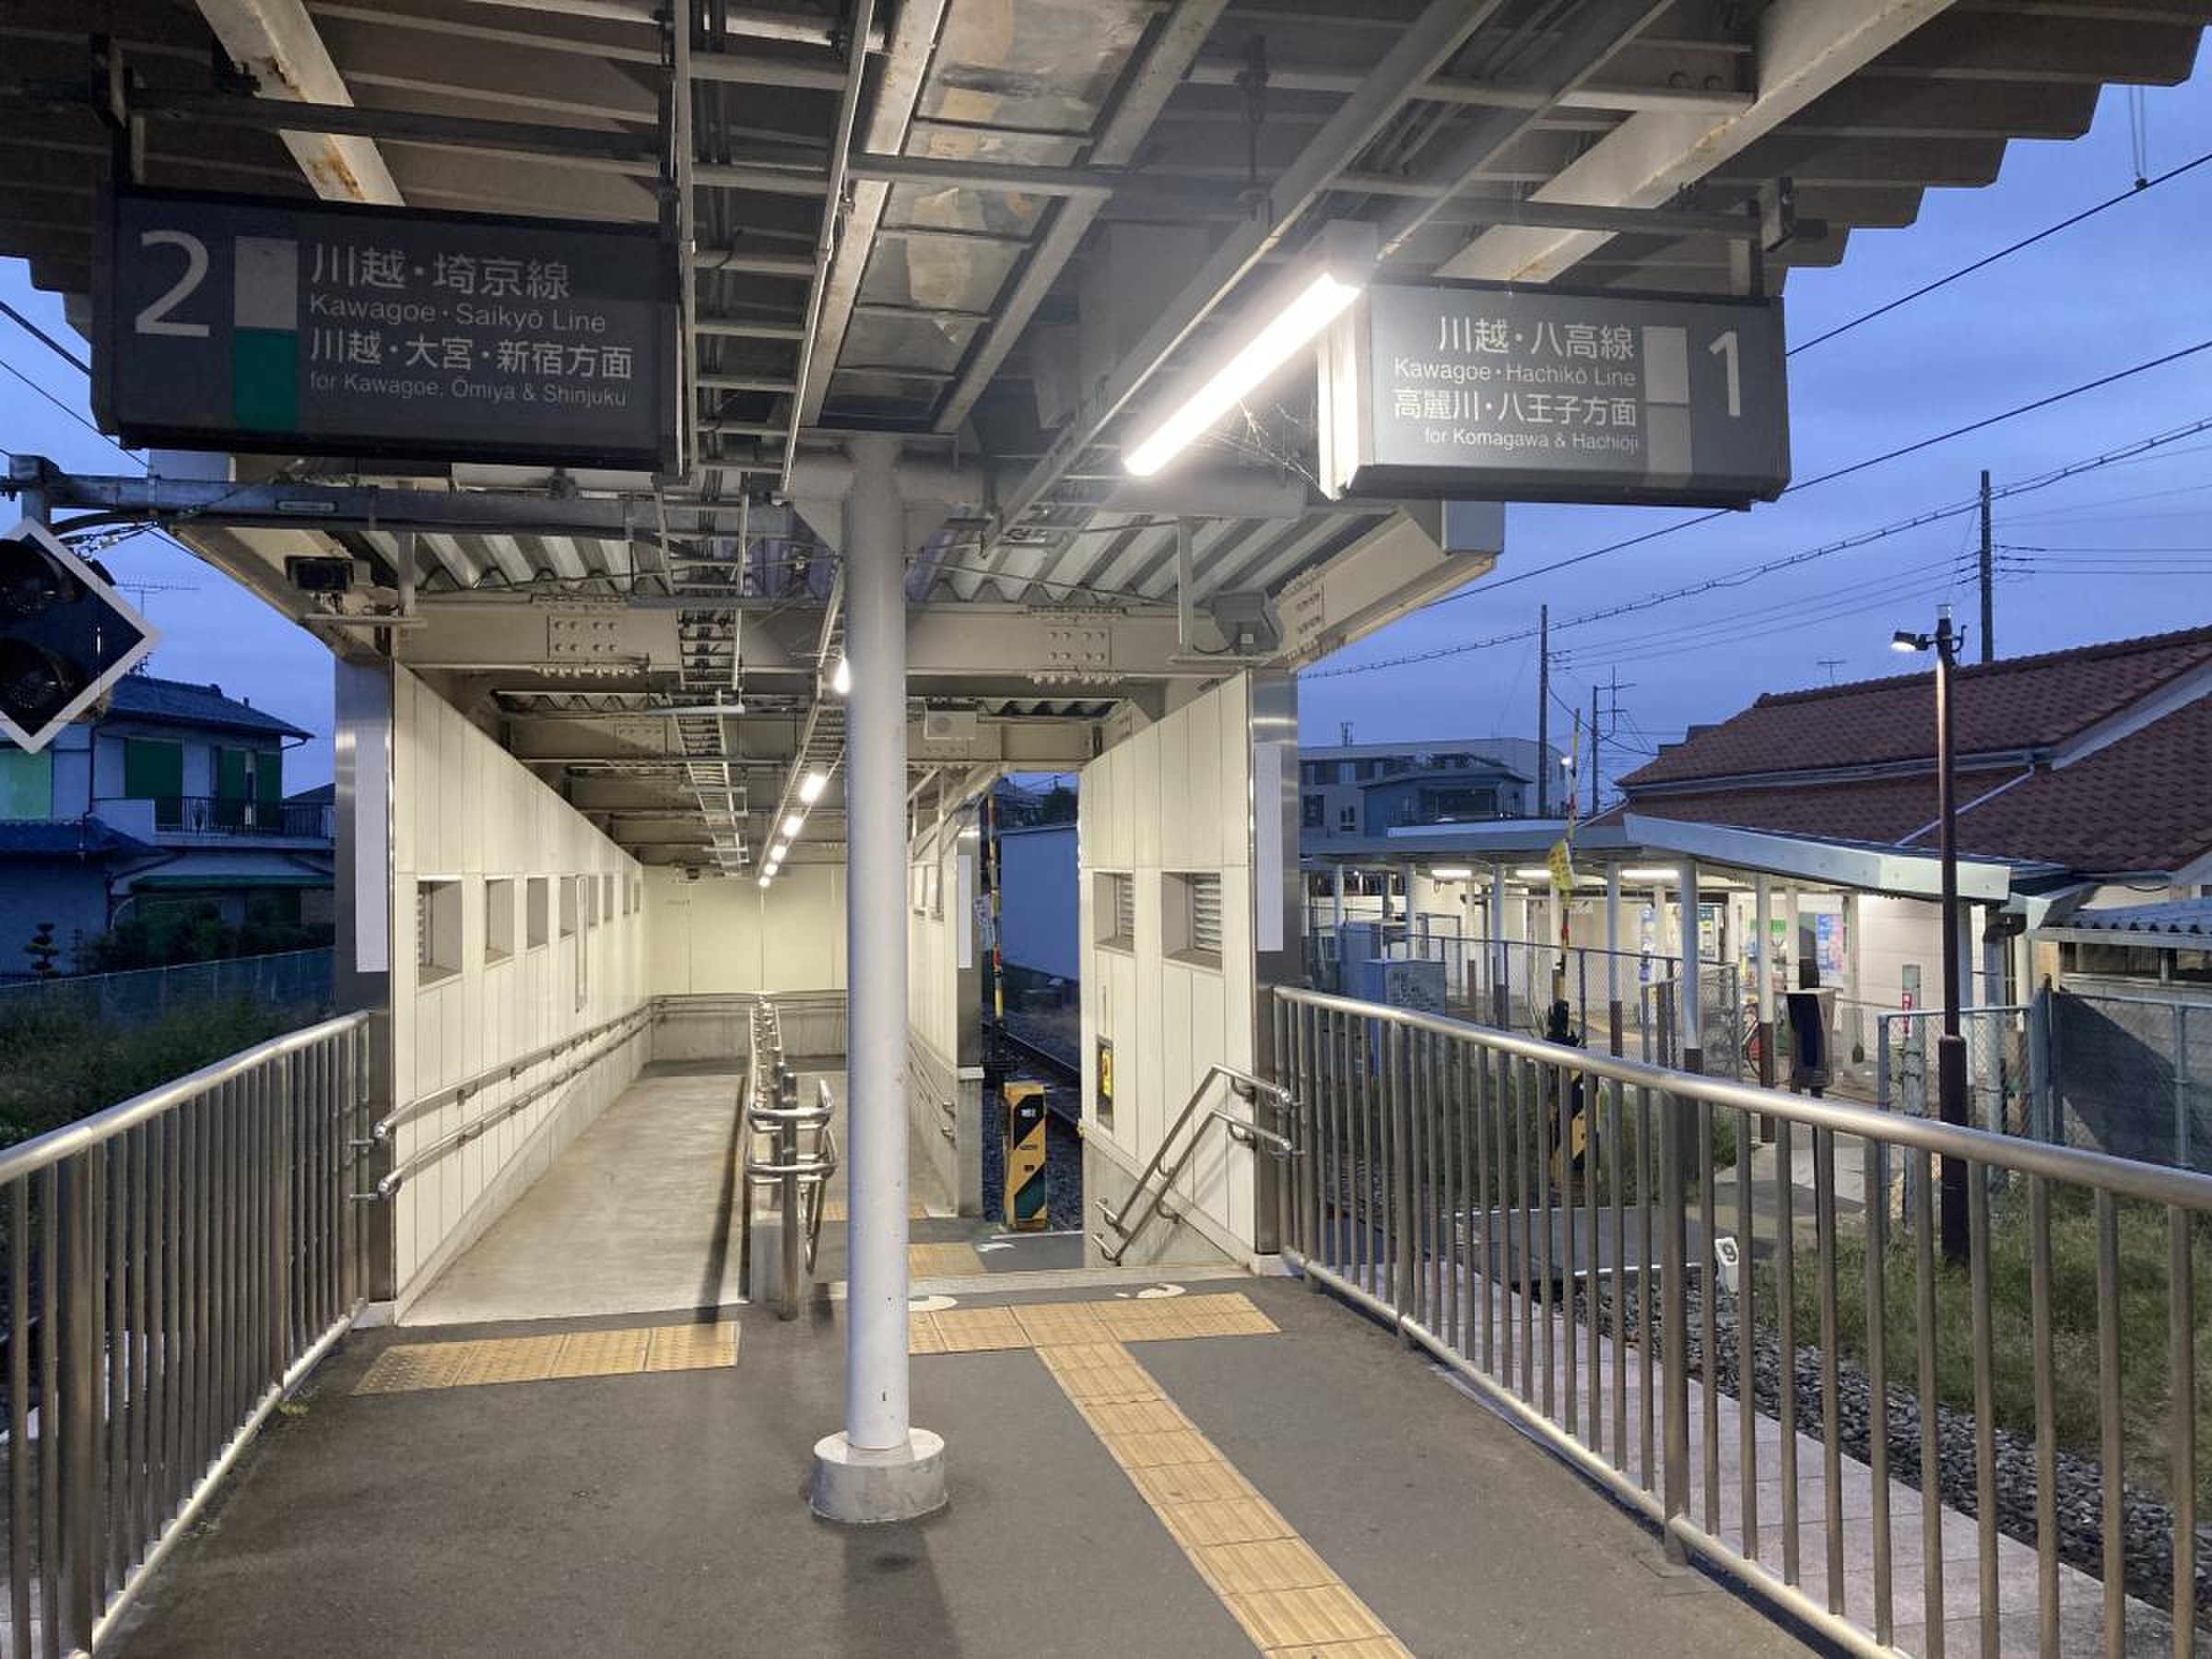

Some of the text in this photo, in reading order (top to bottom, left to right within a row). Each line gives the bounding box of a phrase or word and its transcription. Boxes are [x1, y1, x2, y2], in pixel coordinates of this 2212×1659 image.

[134, 229, 210, 337] 2
[311, 243, 571, 300] 川越・埼京線
[553, 310, 606, 333] Line
[1438, 316, 1635, 360] 川越・八高線
[310, 327, 633, 380] 川越・大宮・新宿方面
[310, 371, 336, 391] for
[522, 383, 534, 401] &
[544, 383, 627, 407] Shinjuku
[1594, 367, 1637, 386] Line
[1708, 331, 1741, 418] 1
[1393, 388, 1637, 427] 高麗川・八王子方面
[1425, 426, 1448, 443] for
[1453, 428, 1549, 451] Komagawa
[1554, 431, 1566, 448] &
[1722, 1243, 1737, 1263] 9
